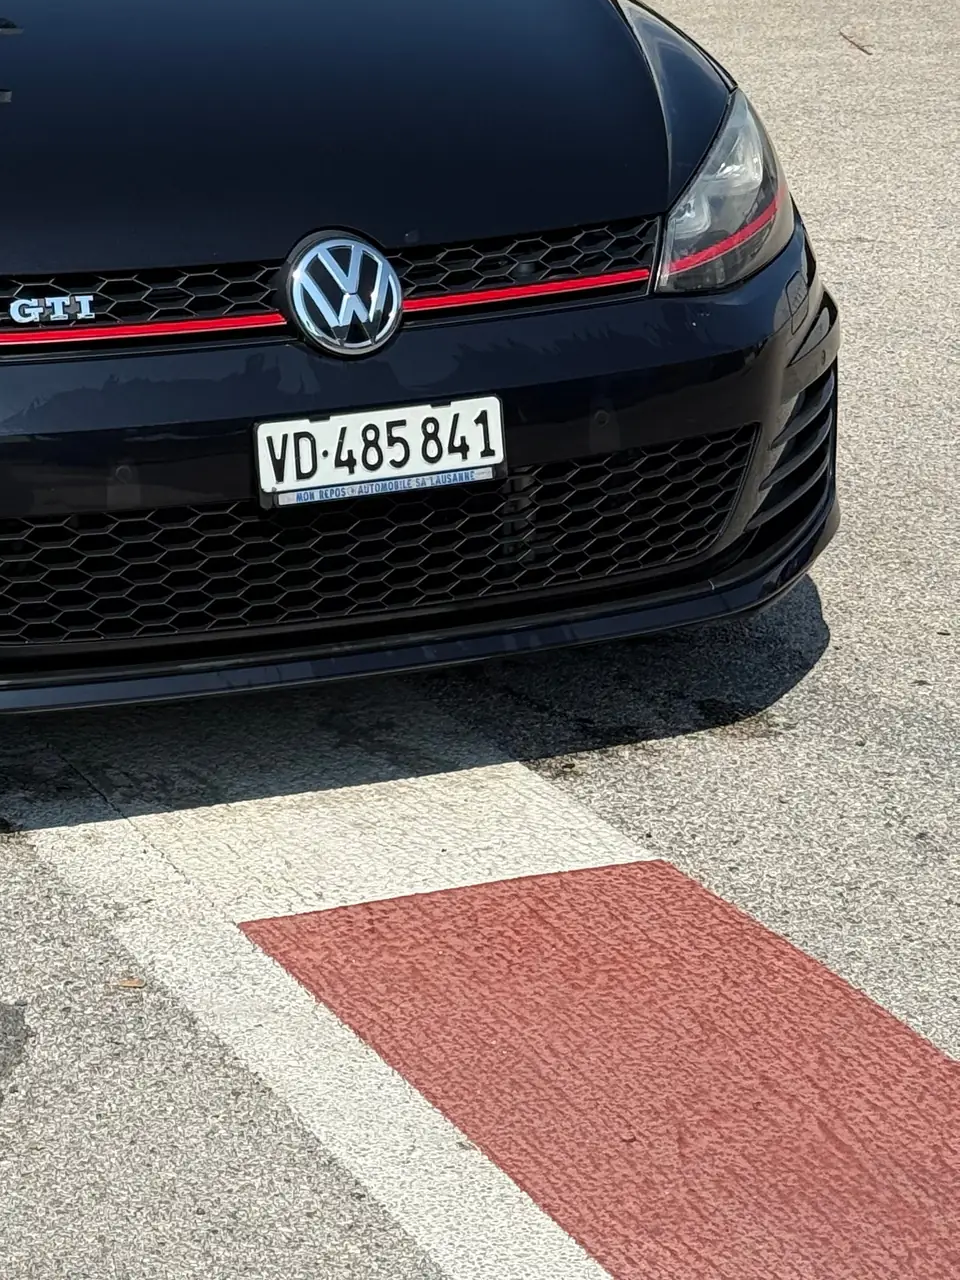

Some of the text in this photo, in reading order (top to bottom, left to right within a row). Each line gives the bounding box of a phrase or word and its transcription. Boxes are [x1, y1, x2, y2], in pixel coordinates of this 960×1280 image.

[10, 295, 95, 323] GTI
[293, 239, 398, 348] VW
[296, 471, 476, 502] MON REPOS AUTOMOBILE SA LAUSANNE
